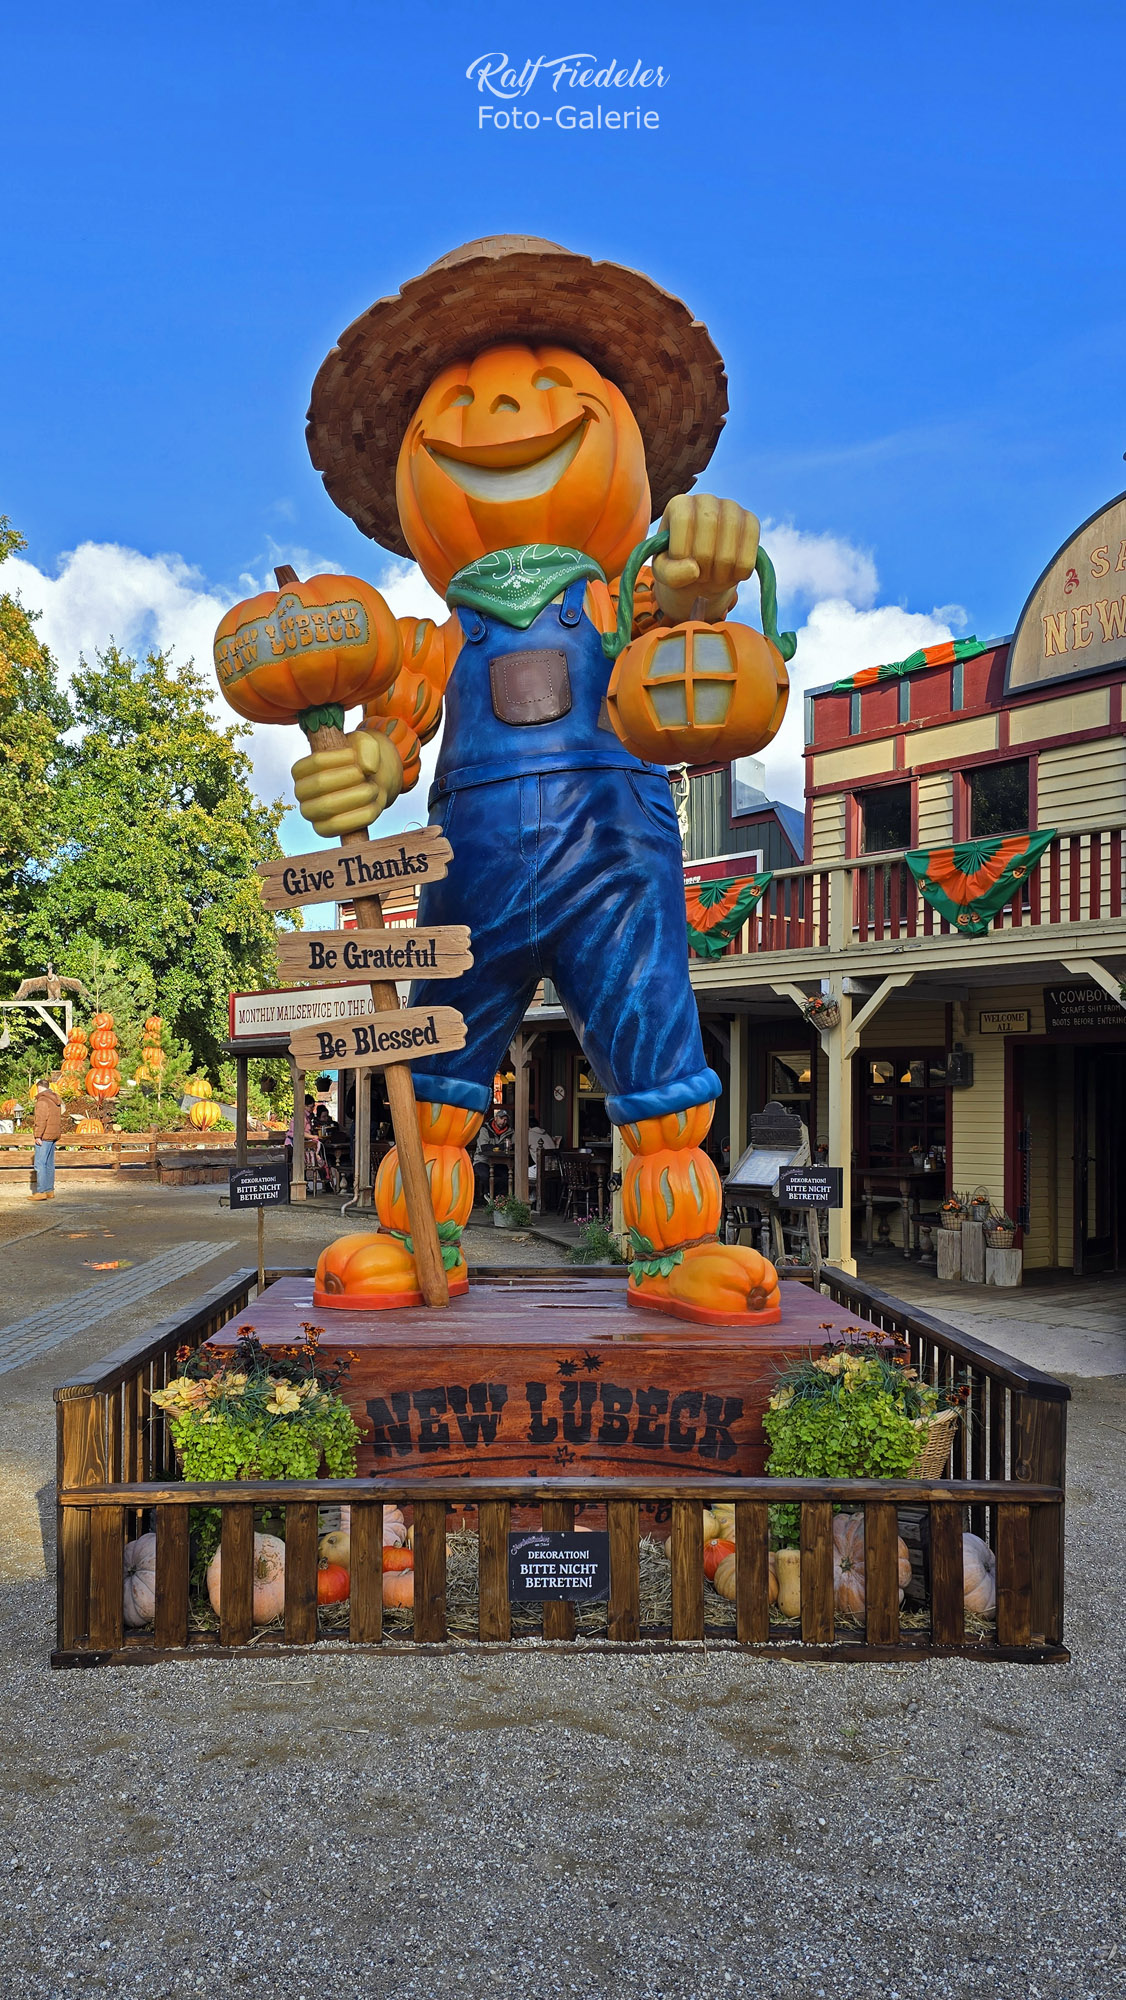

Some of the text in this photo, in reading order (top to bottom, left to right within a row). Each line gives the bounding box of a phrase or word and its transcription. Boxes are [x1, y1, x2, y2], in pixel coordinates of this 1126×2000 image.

[216, 628, 259, 680] NEW
[282, 847, 429, 896] Give Thanks
[308, 938, 438, 970] Be Grateful
[238, 1009, 276, 1024] MONTHLY
[276, 1001, 332, 1021] MAILSERVICE
[333, 1001, 345, 1017] TO
[347, 999, 366, 1016] THE
[983, 1013, 1025, 1023] WELCOME
[1073, 1017, 1094, 1026] BEFORE
[996, 1023, 1013, 1031] ALL
[316, 1016, 440, 1061] Be Blessed
[240, 1176, 277, 1184] DEKORATION!
[236, 1183, 281, 1194] BITTE NICHT
[808, 1185, 831, 1193] NICHT
[240, 1191, 279, 1201] BETRETEN!
[788, 1192, 828, 1201] BETRETEN!
[366, 1383, 508, 1459] NEW
[527, 1550, 590, 1560] DEKORATION!
[519, 1563, 599, 1575] BITTE NICHT
[525, 1576, 593, 1588] BETRETEN!
